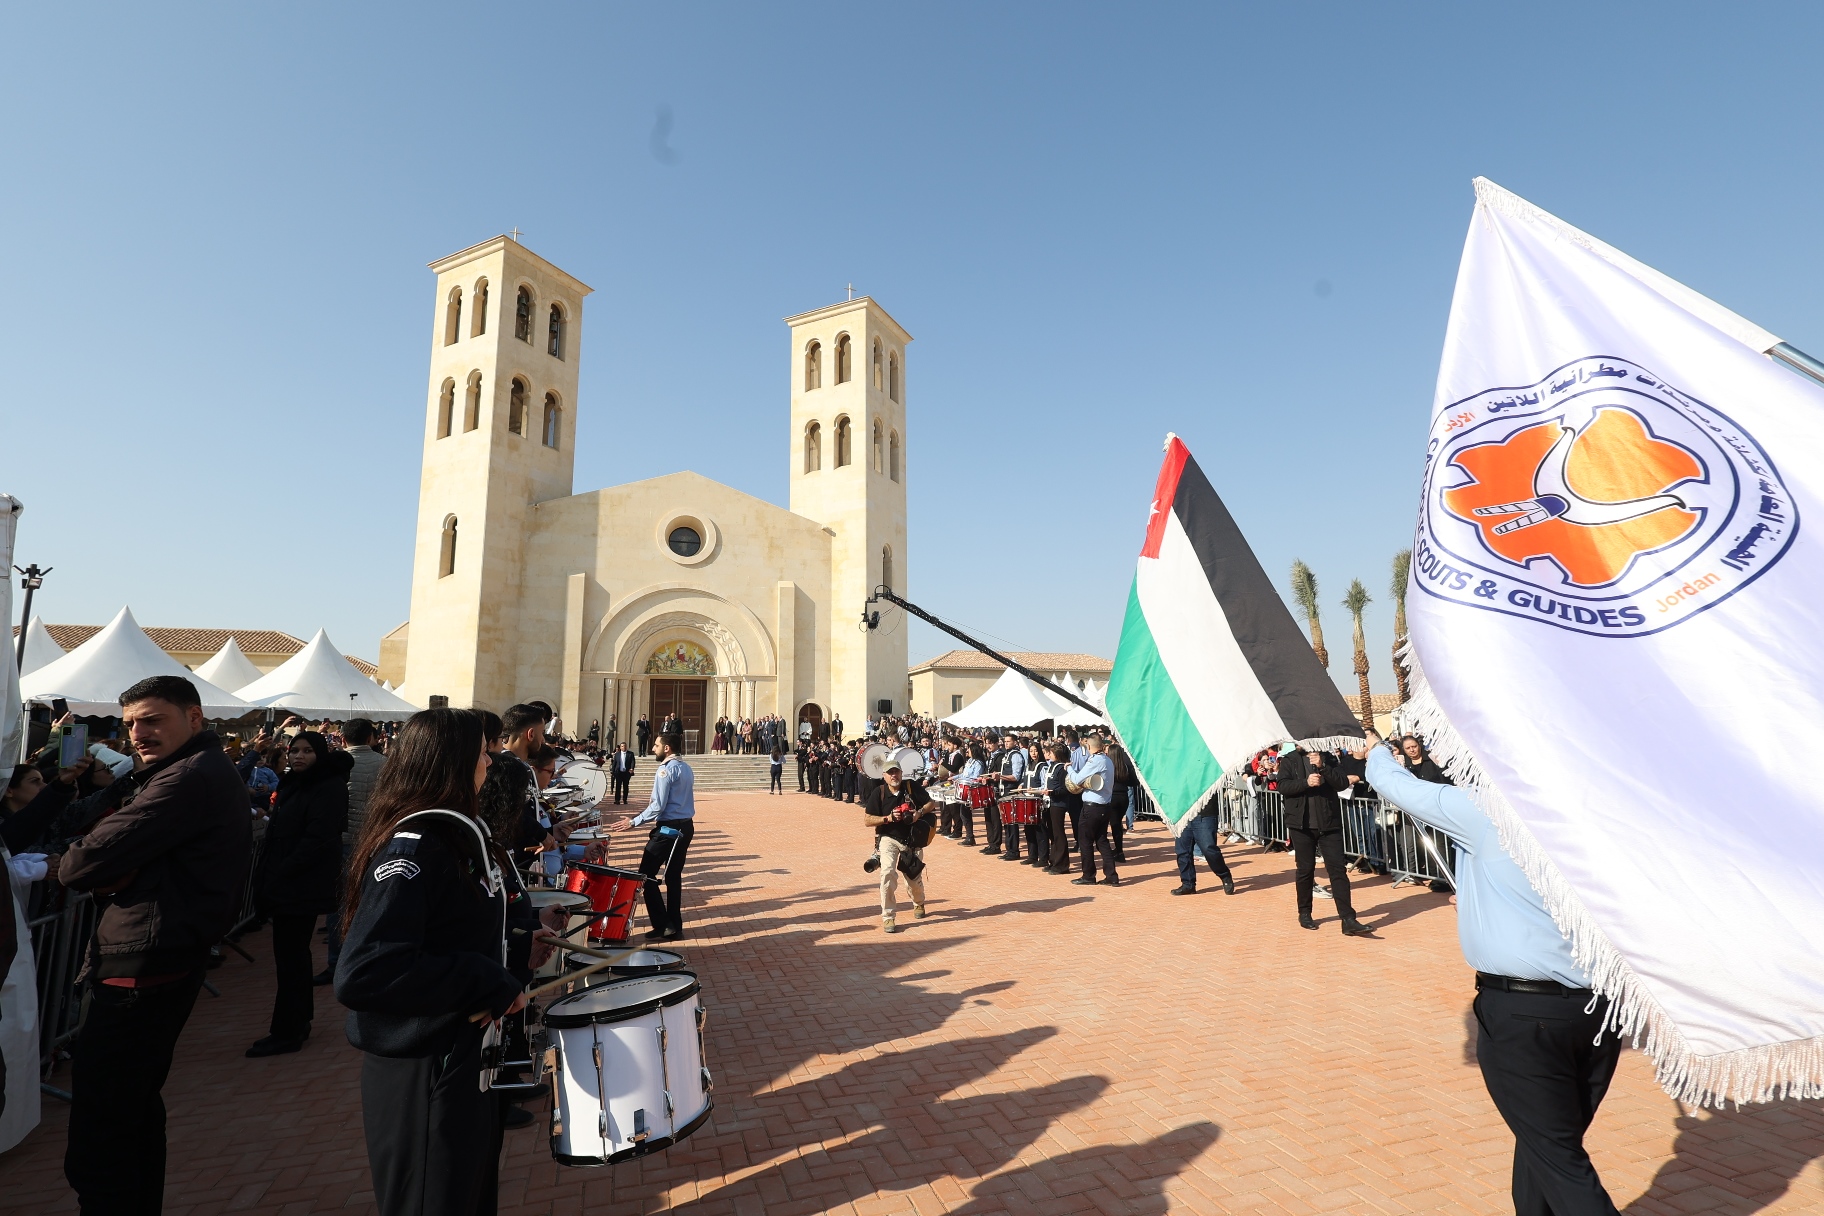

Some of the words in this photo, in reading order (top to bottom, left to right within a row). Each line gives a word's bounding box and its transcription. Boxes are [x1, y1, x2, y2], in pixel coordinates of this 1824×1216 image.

[1550, 363, 1628, 395] مطرانية
[1487, 389, 1545, 413] اللاتين
[1417, 538, 1473, 591] SCOUTS
[1473, 579, 1499, 600] &
[1507, 589, 1646, 628] GUIDES
[1655, 572, 1722, 613] Jordan
